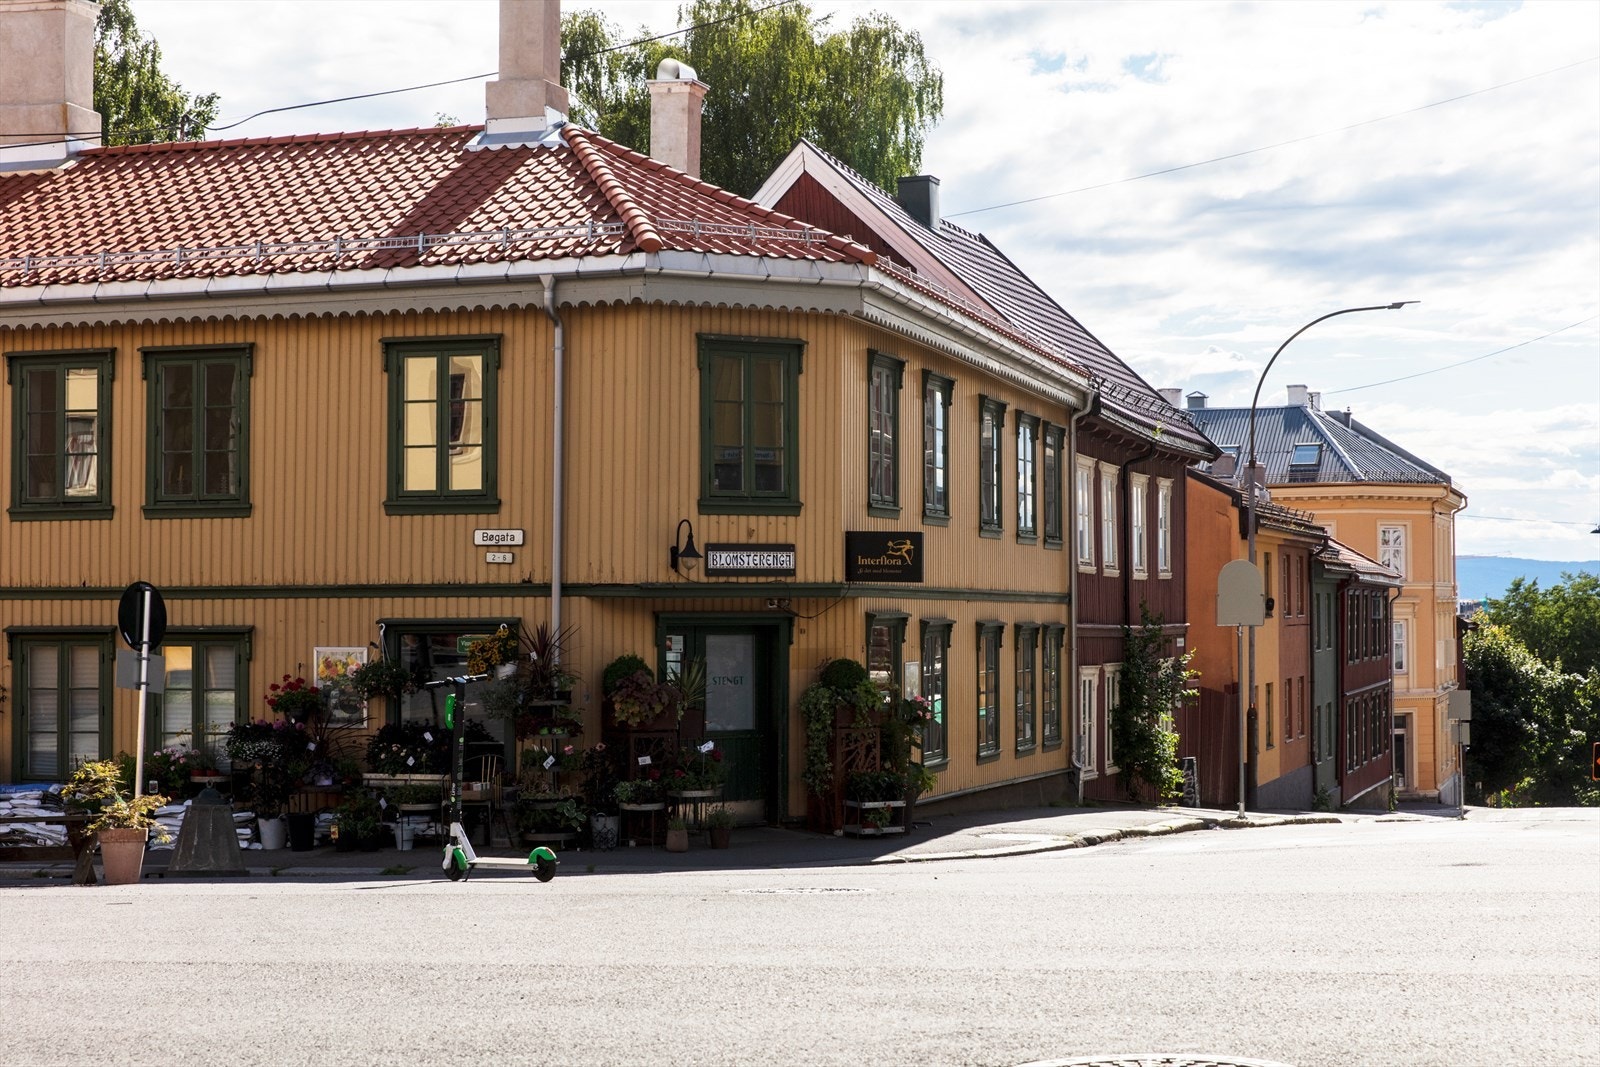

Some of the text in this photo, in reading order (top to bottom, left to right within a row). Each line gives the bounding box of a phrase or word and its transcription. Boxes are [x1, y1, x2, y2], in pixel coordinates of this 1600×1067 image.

[482, 532, 515, 544] Bøgata
[712, 554, 791, 566] BLOMSTERENGA
[858, 555, 902, 565] Interflora
[712, 676, 744, 686] STENGT
